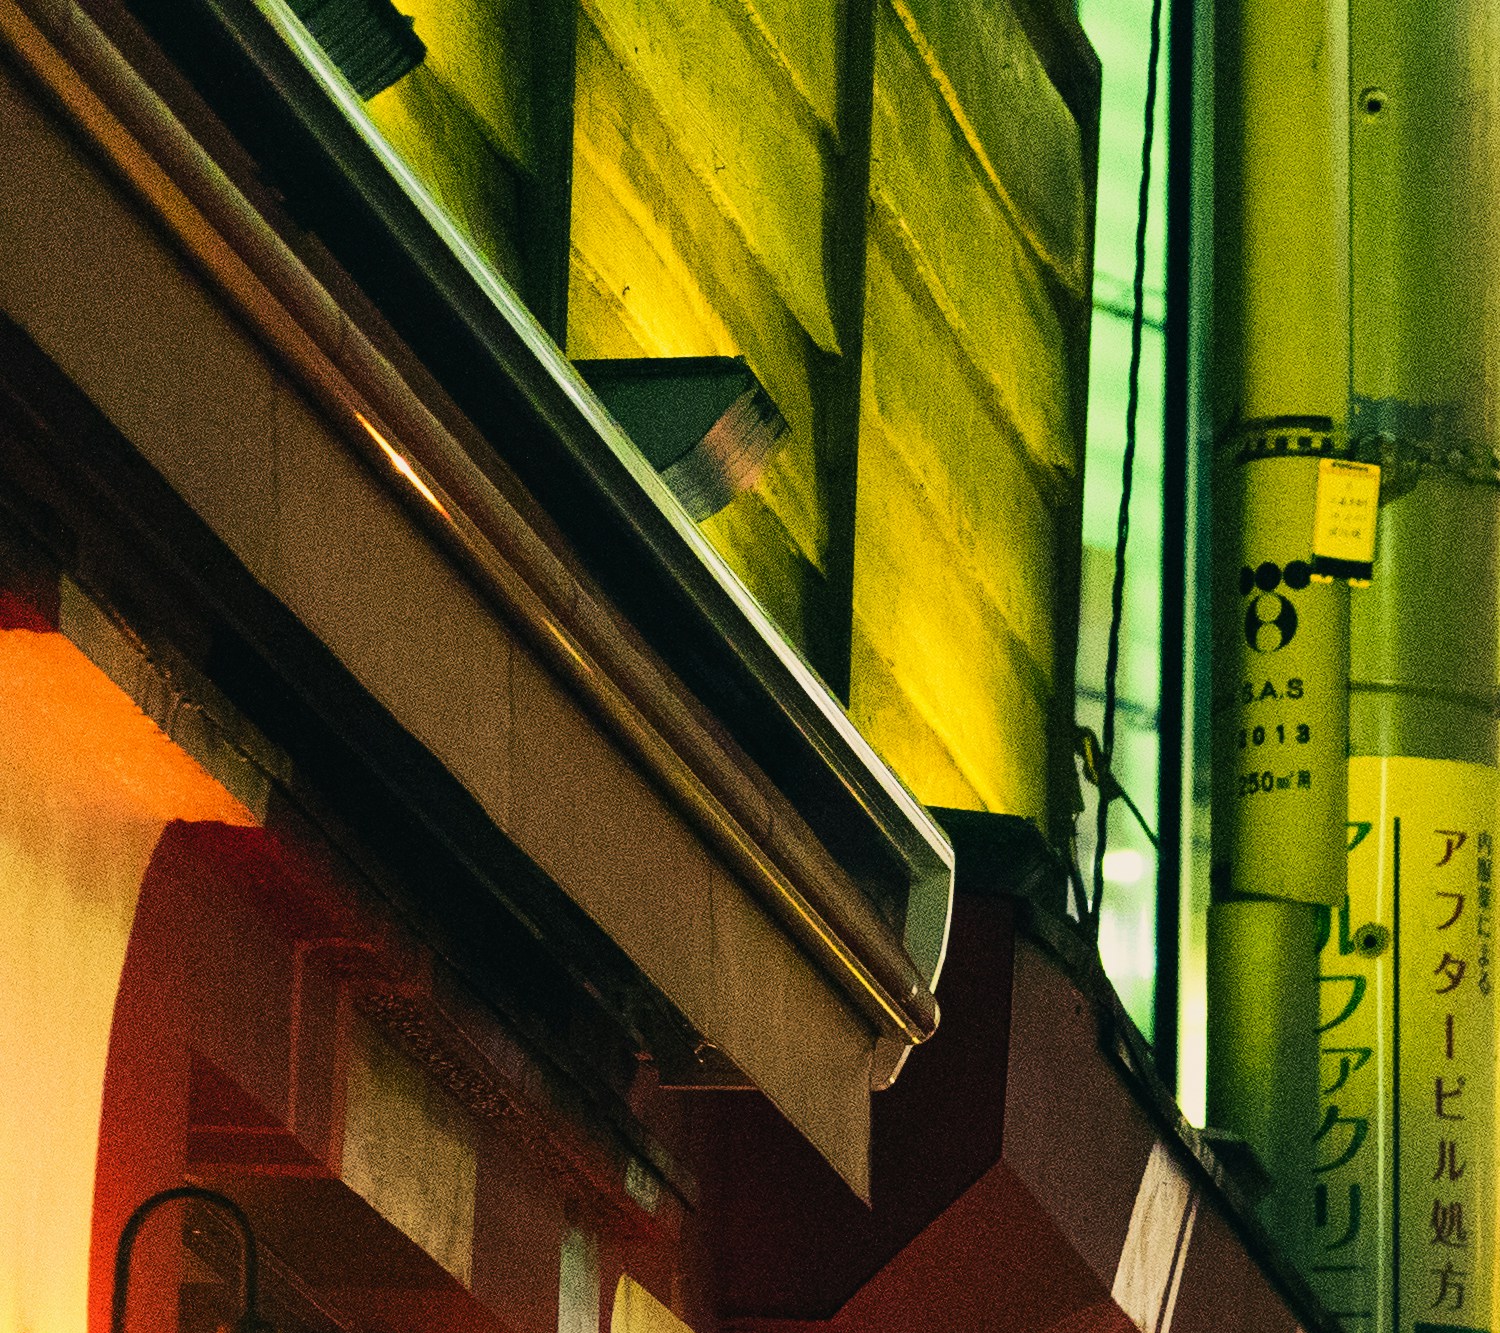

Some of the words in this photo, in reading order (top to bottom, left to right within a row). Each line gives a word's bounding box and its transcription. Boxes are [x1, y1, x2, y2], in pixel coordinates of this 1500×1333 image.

[1430, 828, 1468, 1311] アフターピル処方
